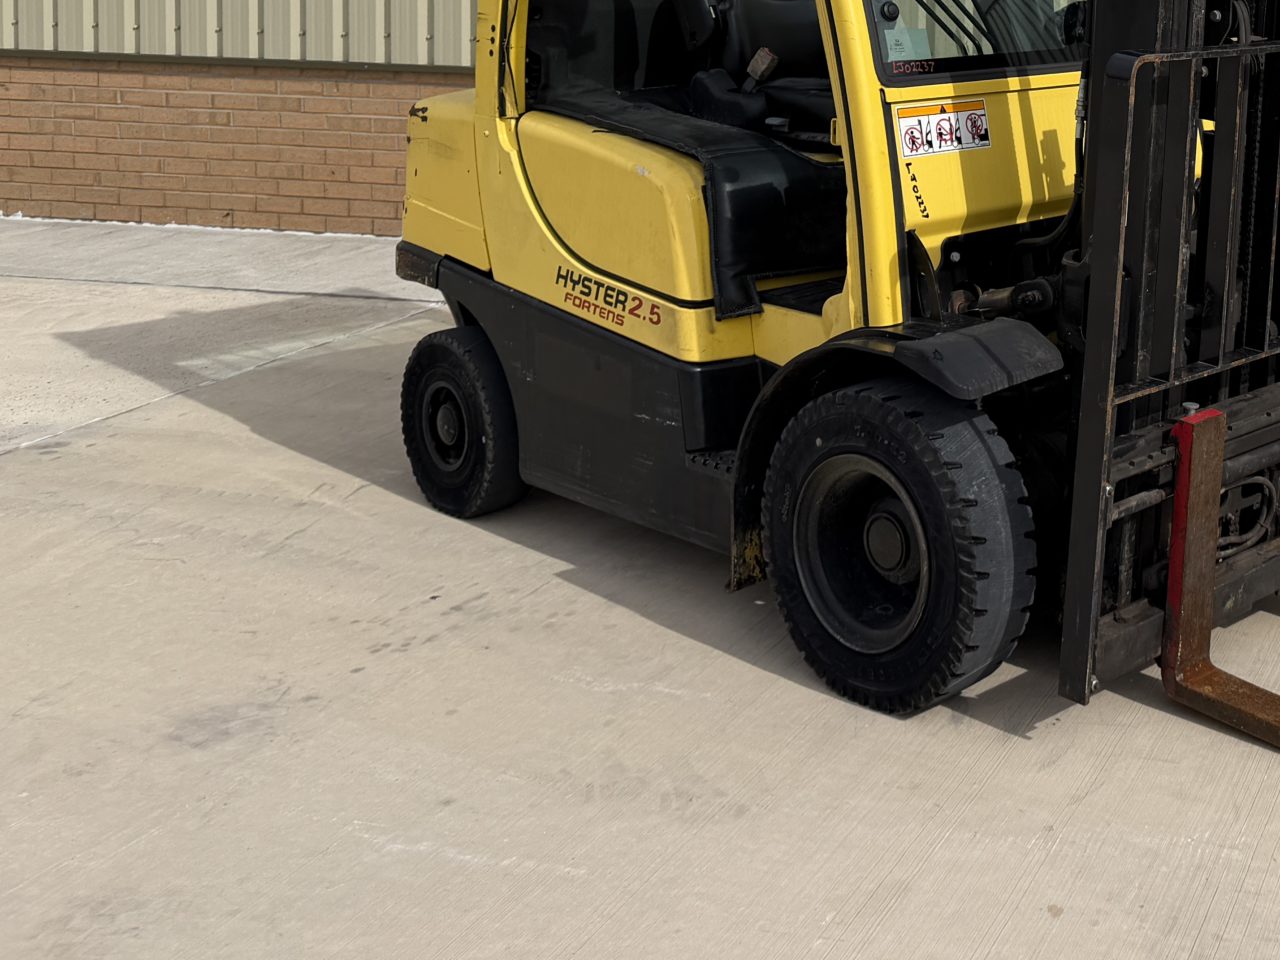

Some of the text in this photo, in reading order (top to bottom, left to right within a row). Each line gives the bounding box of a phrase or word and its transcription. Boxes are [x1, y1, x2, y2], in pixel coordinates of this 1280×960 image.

[555, 265, 662, 326] HYSTER 2.5
[564, 292, 625, 327] FORTENS
